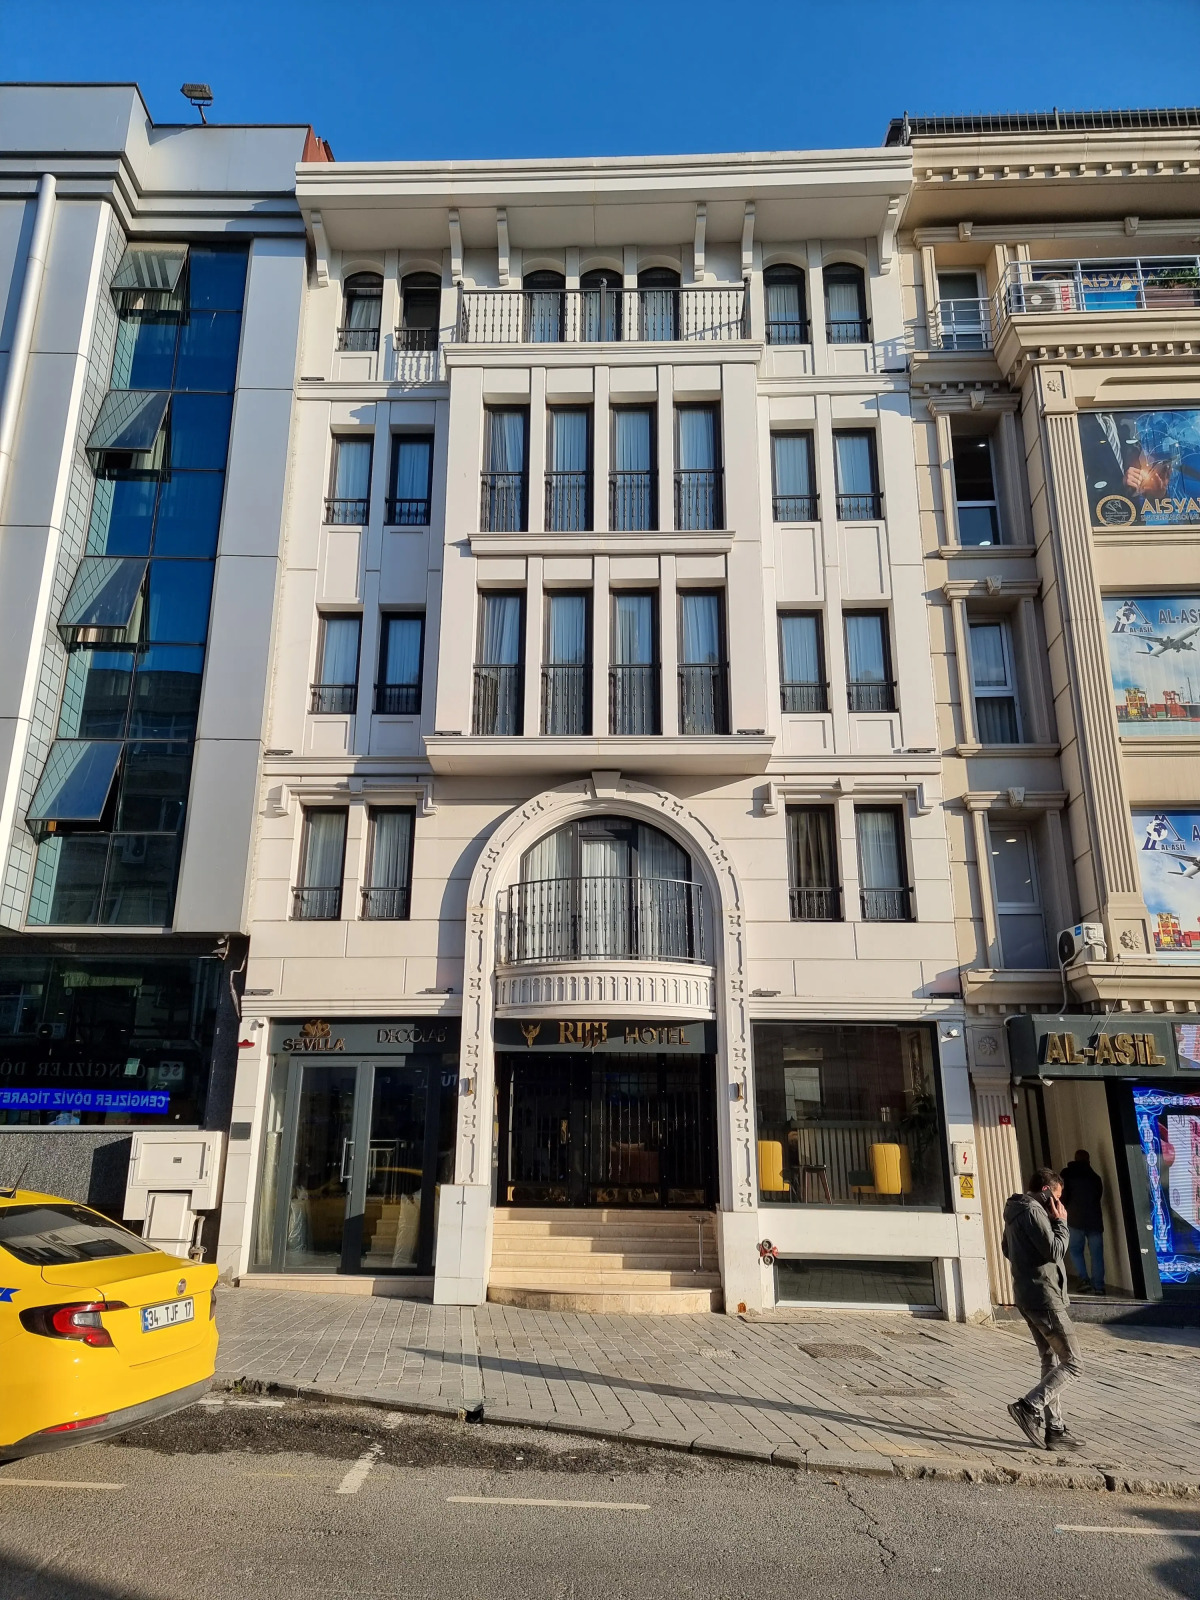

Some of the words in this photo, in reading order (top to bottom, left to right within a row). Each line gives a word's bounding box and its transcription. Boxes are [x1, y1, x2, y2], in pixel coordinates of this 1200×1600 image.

[377, 1027, 447, 1043] DECOLAB
[624, 1027, 691, 1045] HOTEL
[148, 1310, 159, 1327] 34
[165, 1304, 179, 1322] TJF
[184, 1301, 192, 1318] 17
